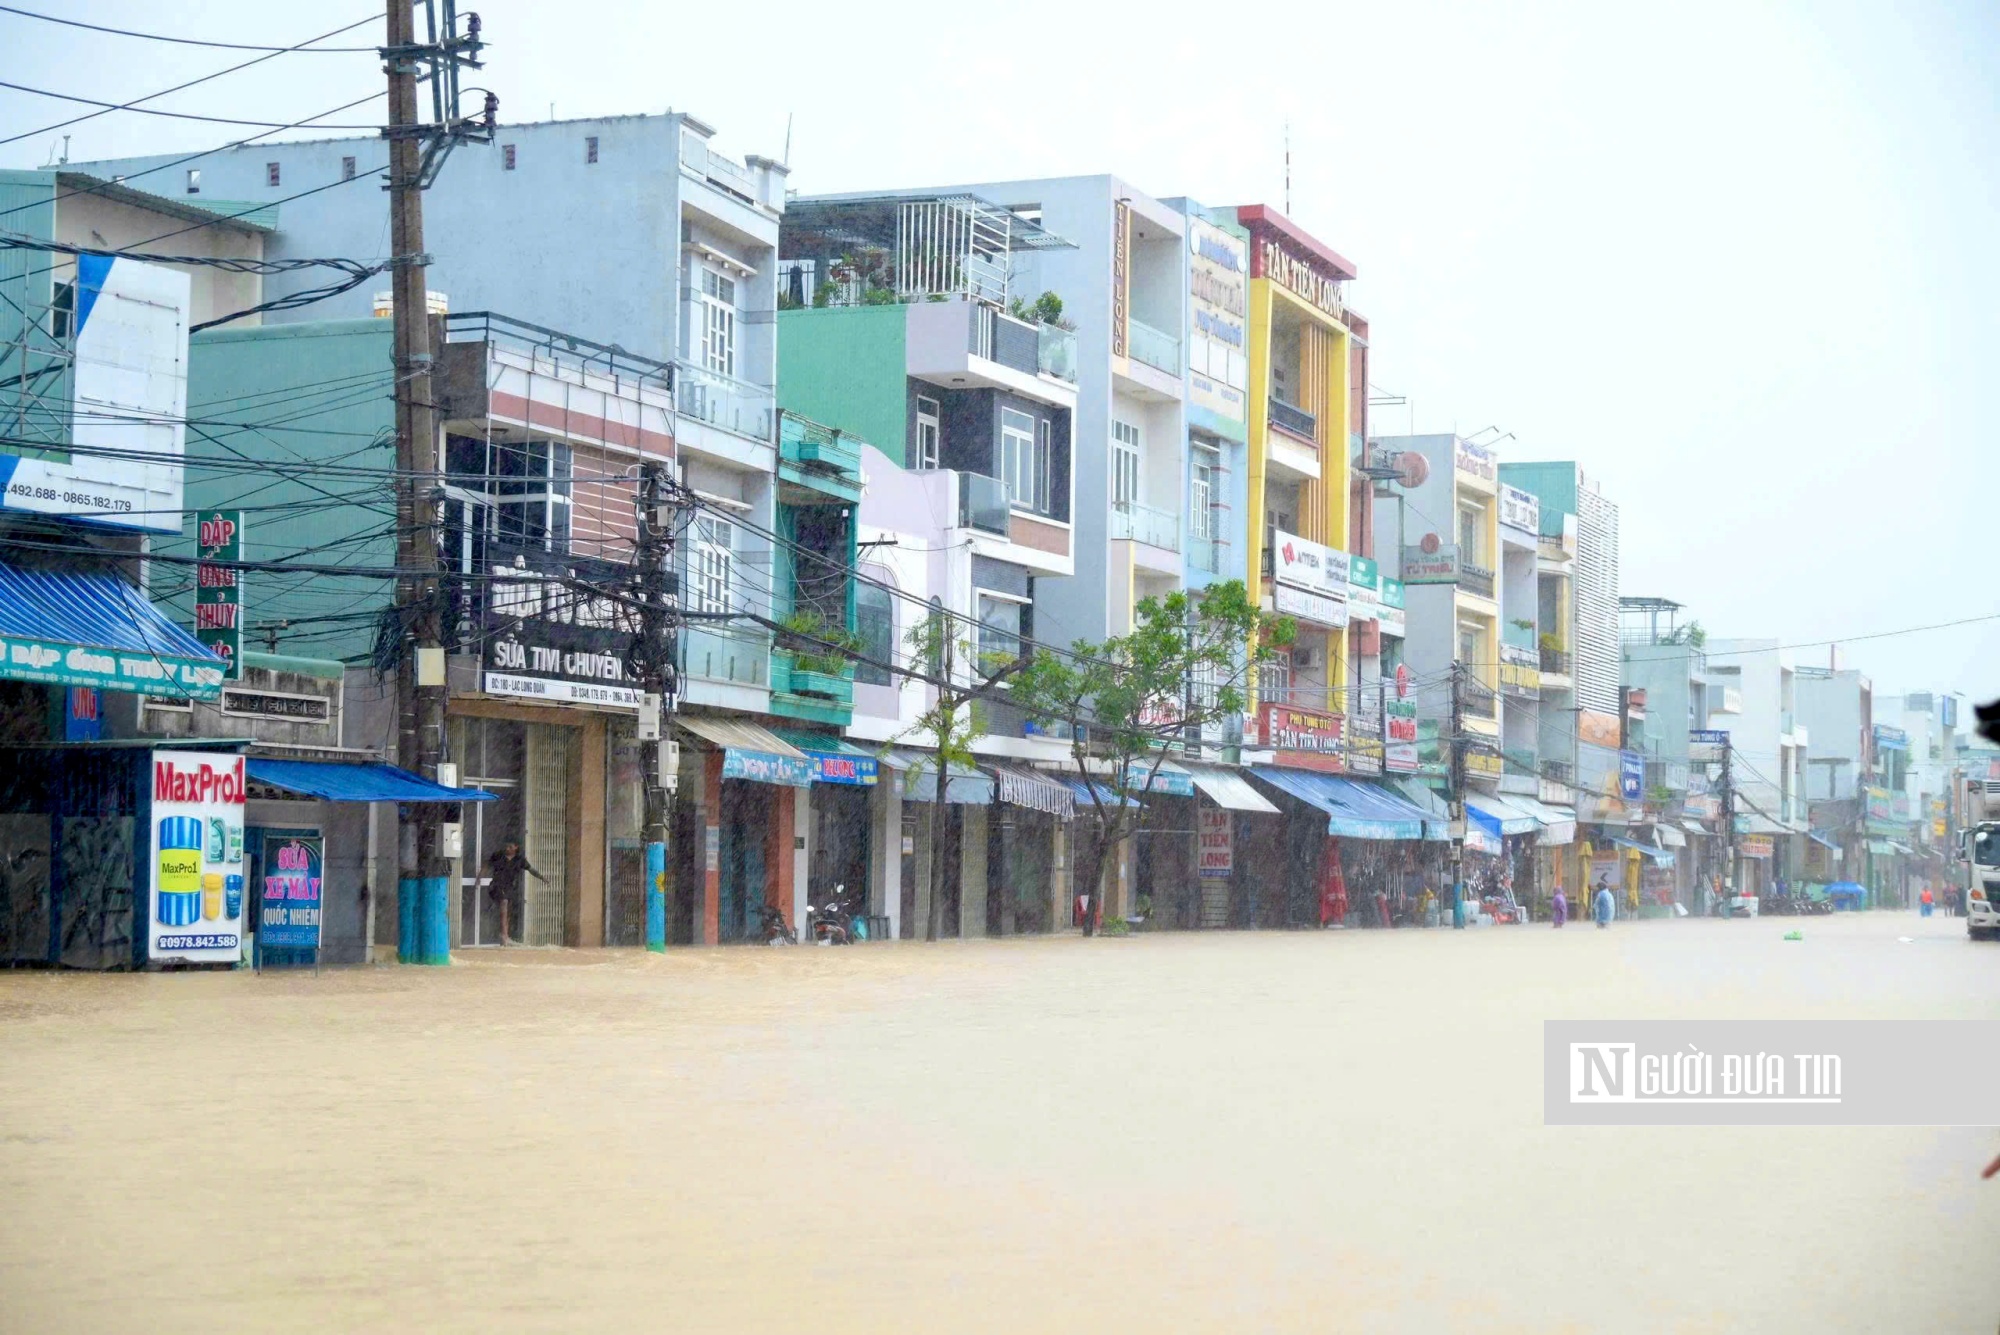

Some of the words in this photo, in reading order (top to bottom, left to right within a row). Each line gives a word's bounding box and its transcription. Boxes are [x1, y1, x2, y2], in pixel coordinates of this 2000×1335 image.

[1266, 241, 1291, 289] TÂN
[1291, 260, 1317, 306] TIẾN
[1317, 275, 1345, 321] LONG
[1114, 284, 1124, 355] LONG
[530, 645, 560, 674] TIM
[563, 649, 623, 682] CHUYÊN
[1279, 725, 1297, 748] TÂN
[155, 757, 246, 804] MaxPro1
[161, 861, 198, 875] MaxPro1
[277, 839, 309, 871] SỬA
[1199, 852, 1231, 867] LONG
[264, 876, 284, 900] XE
[263, 901, 288, 927] QUỐC
[289, 904, 320, 931] NHIỆM
[167, 936, 237, 949] 0978.842.588
